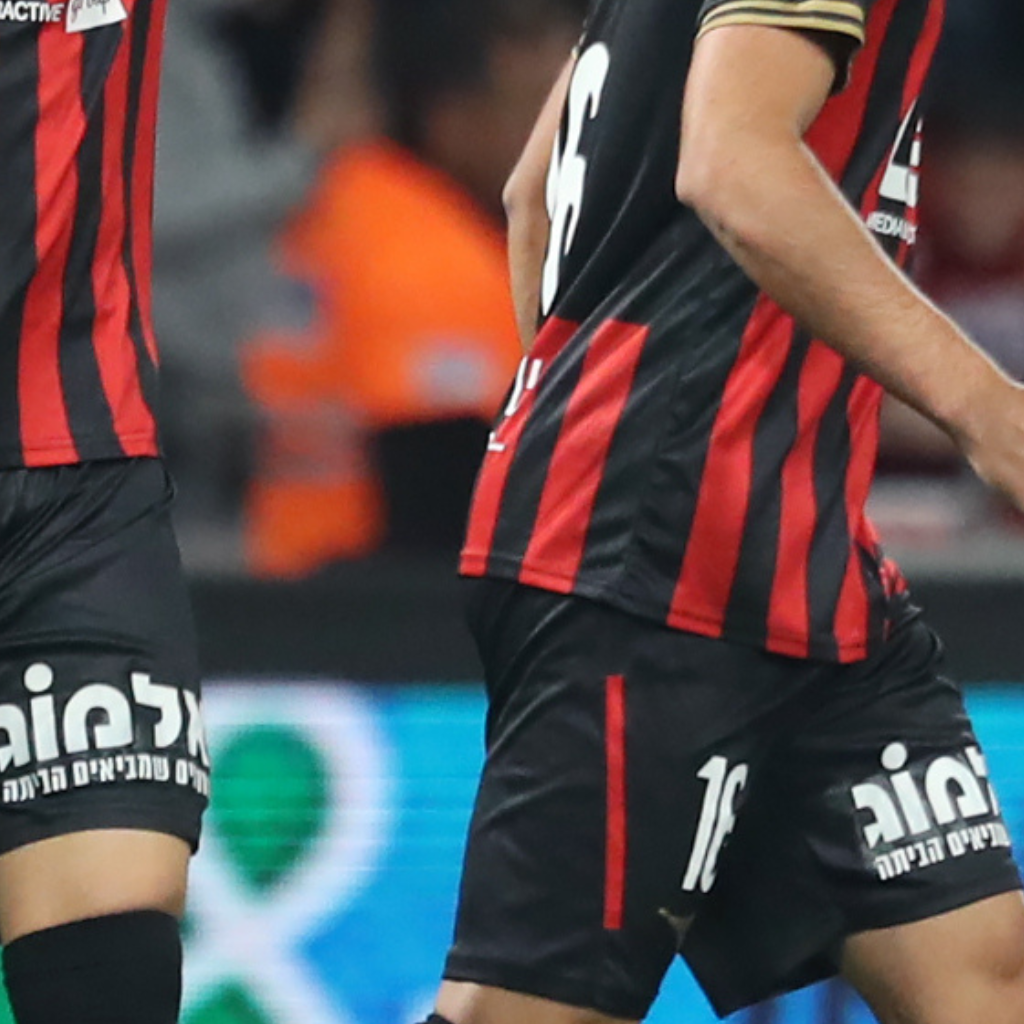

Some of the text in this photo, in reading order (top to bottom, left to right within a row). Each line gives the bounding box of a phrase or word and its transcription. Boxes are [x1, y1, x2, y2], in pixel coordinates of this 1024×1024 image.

[2, 764, 68, 804] הביתה
[72, 752, 170, 788] שמביאים
[874, 836, 946, 882] הביתה
